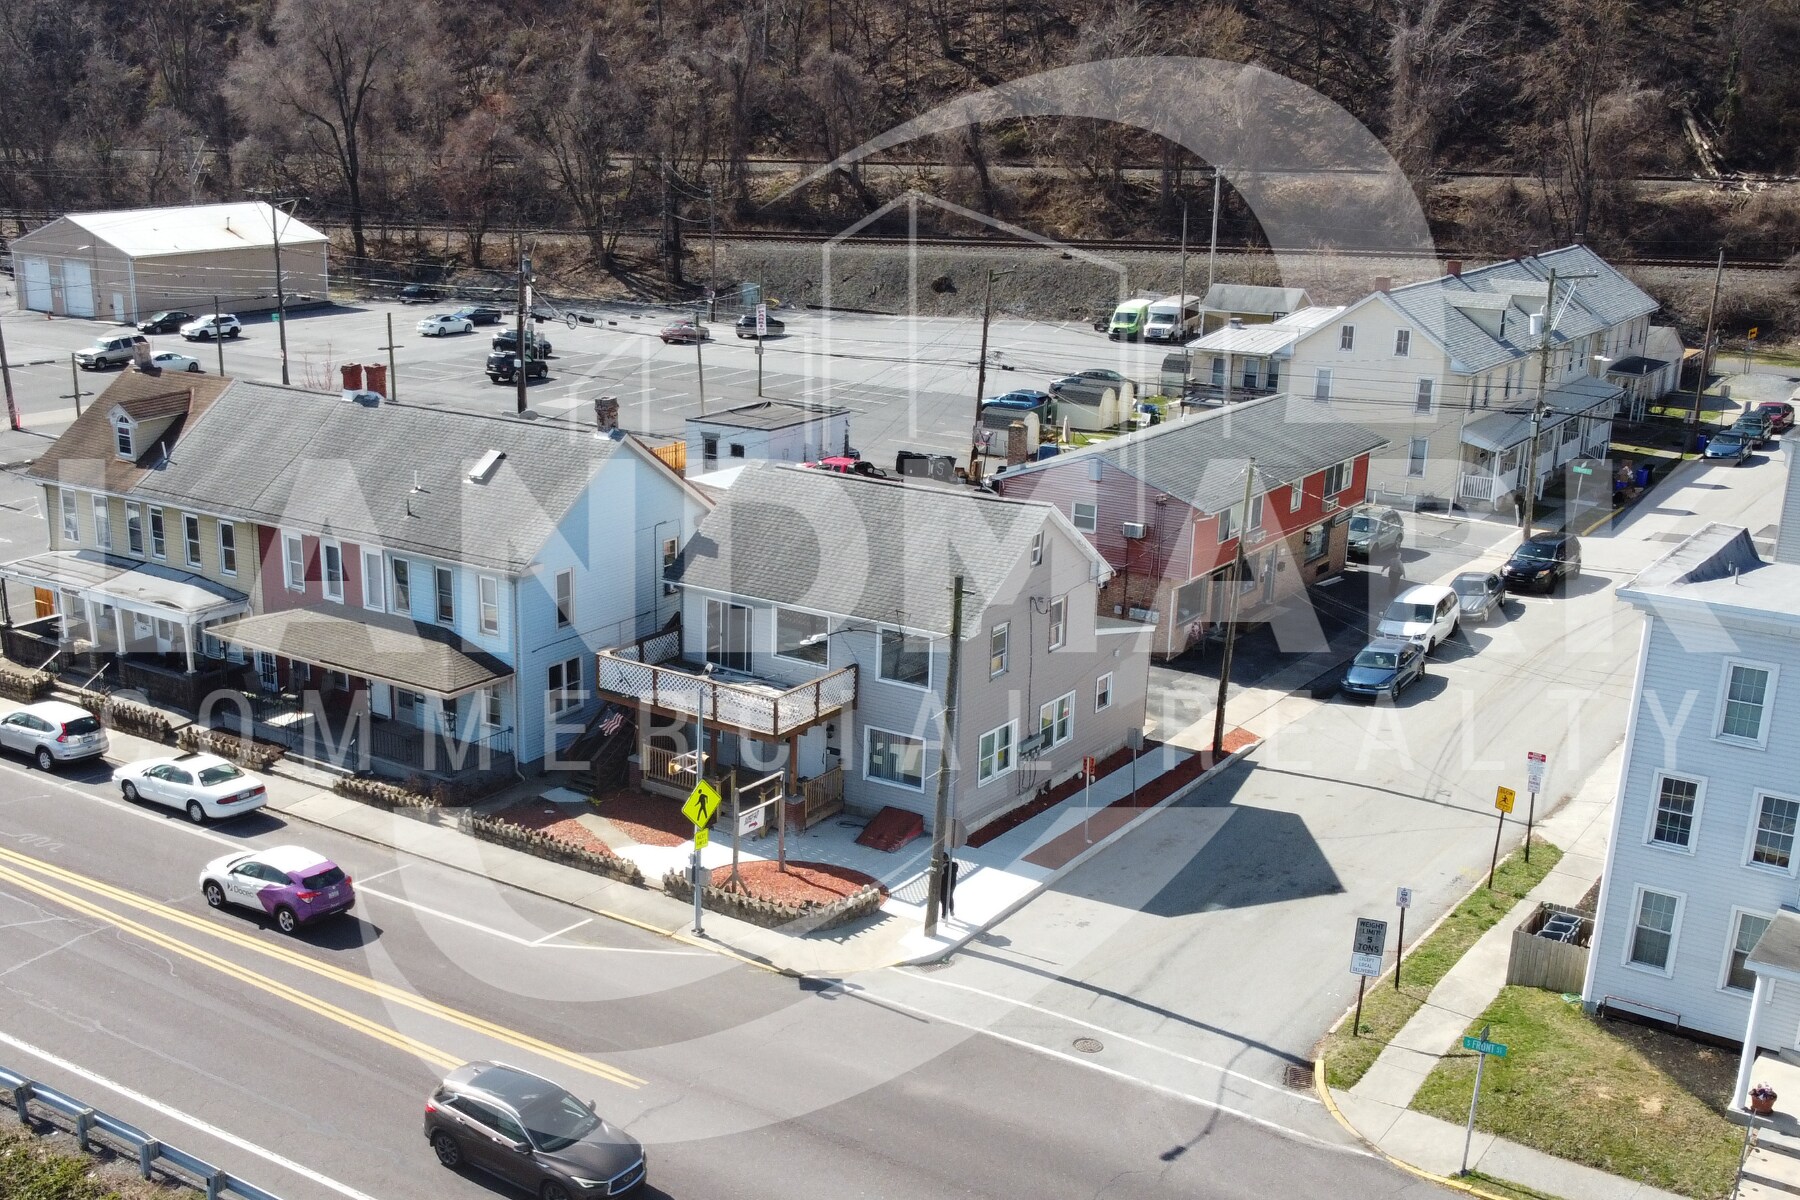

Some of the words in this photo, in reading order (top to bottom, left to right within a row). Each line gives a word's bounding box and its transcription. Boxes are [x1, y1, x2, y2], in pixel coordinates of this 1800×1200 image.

[1360, 921, 1384, 930] WEIGHT
[1362, 928, 1381, 936] LIMIT
[1358, 943, 1380, 953] TONS
[1472, 1040, 1495, 1053] FRONT
